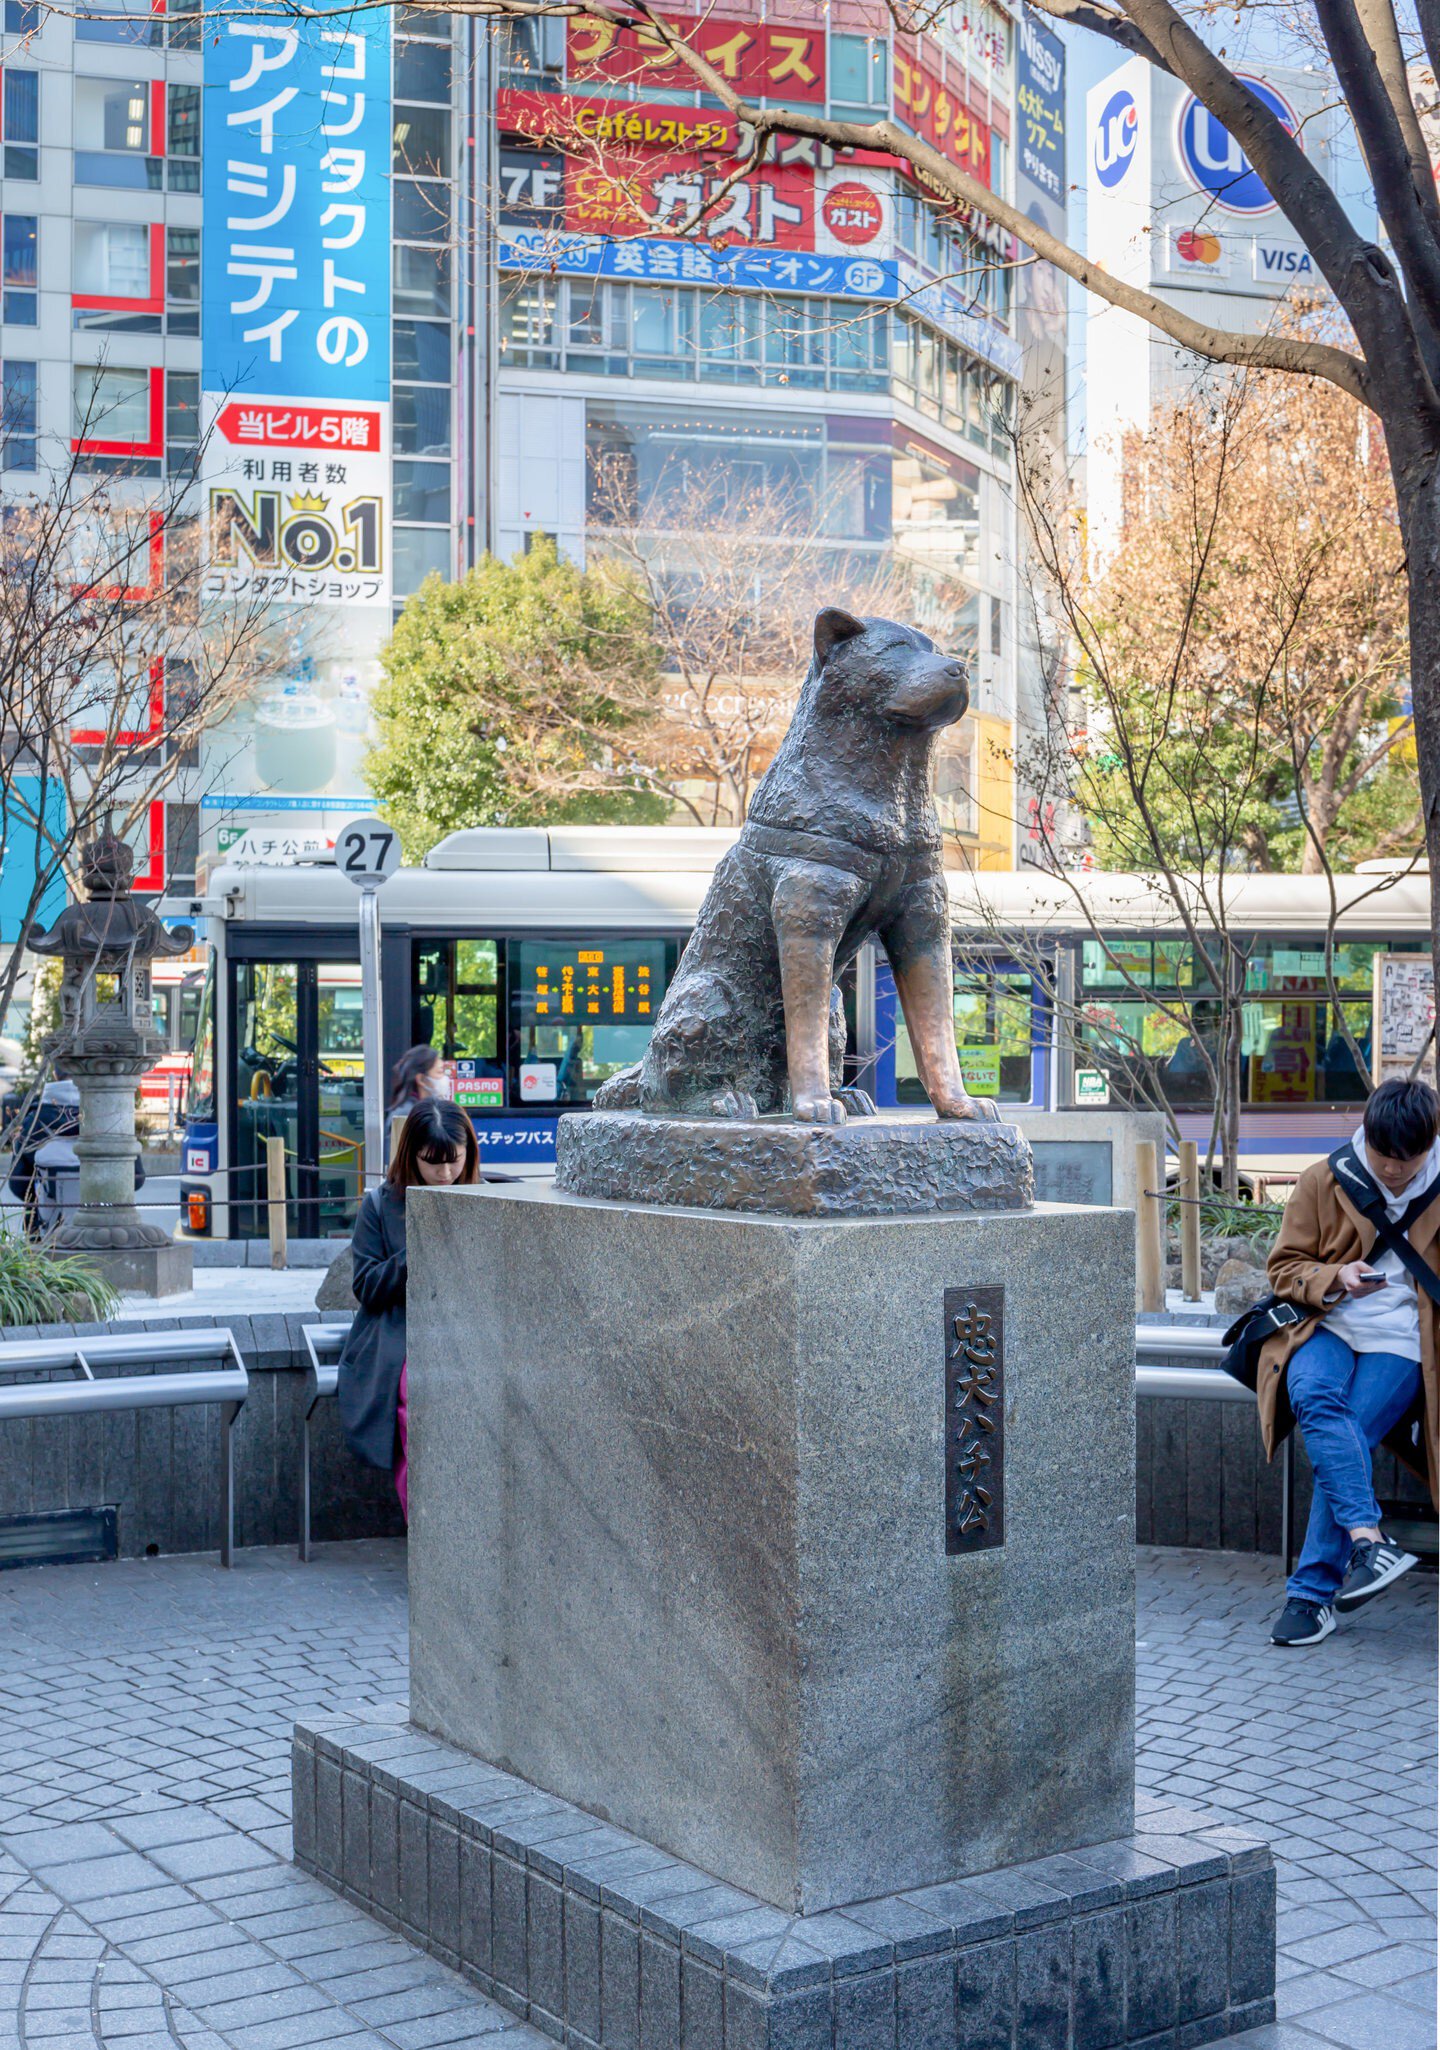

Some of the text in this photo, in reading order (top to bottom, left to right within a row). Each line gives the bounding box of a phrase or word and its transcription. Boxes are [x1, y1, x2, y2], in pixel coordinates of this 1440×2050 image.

[1020, 22, 1061, 92] Nissy
[893, 56, 985, 167] コンタクト
[227, 22, 300, 363] アイシティ
[316, 31, 369, 368] コンタクトの
[501, 167, 561, 208] 7F
[653, 174, 801, 241] ガスト
[830, 207, 878, 228] ガスト
[613, 241, 834, 286] 英会話イーオン
[1258, 247, 1312, 274] VISA
[238, 411, 370, 447] 当ビル5階
[243, 458, 348, 485] 利用者数
[209, 487, 383, 574] No.1
[207, 574, 384, 600] コンタクトショップ
[219, 829, 239, 846] 6F
[344, 832, 394, 872] 27
[457, 1081, 499, 1091] PASMO
[459, 1094, 498, 1104] Suica
[477, 1131, 555, 1145] ステップバス
[950, 1303, 998, 1534] 忠犬ハチ公
